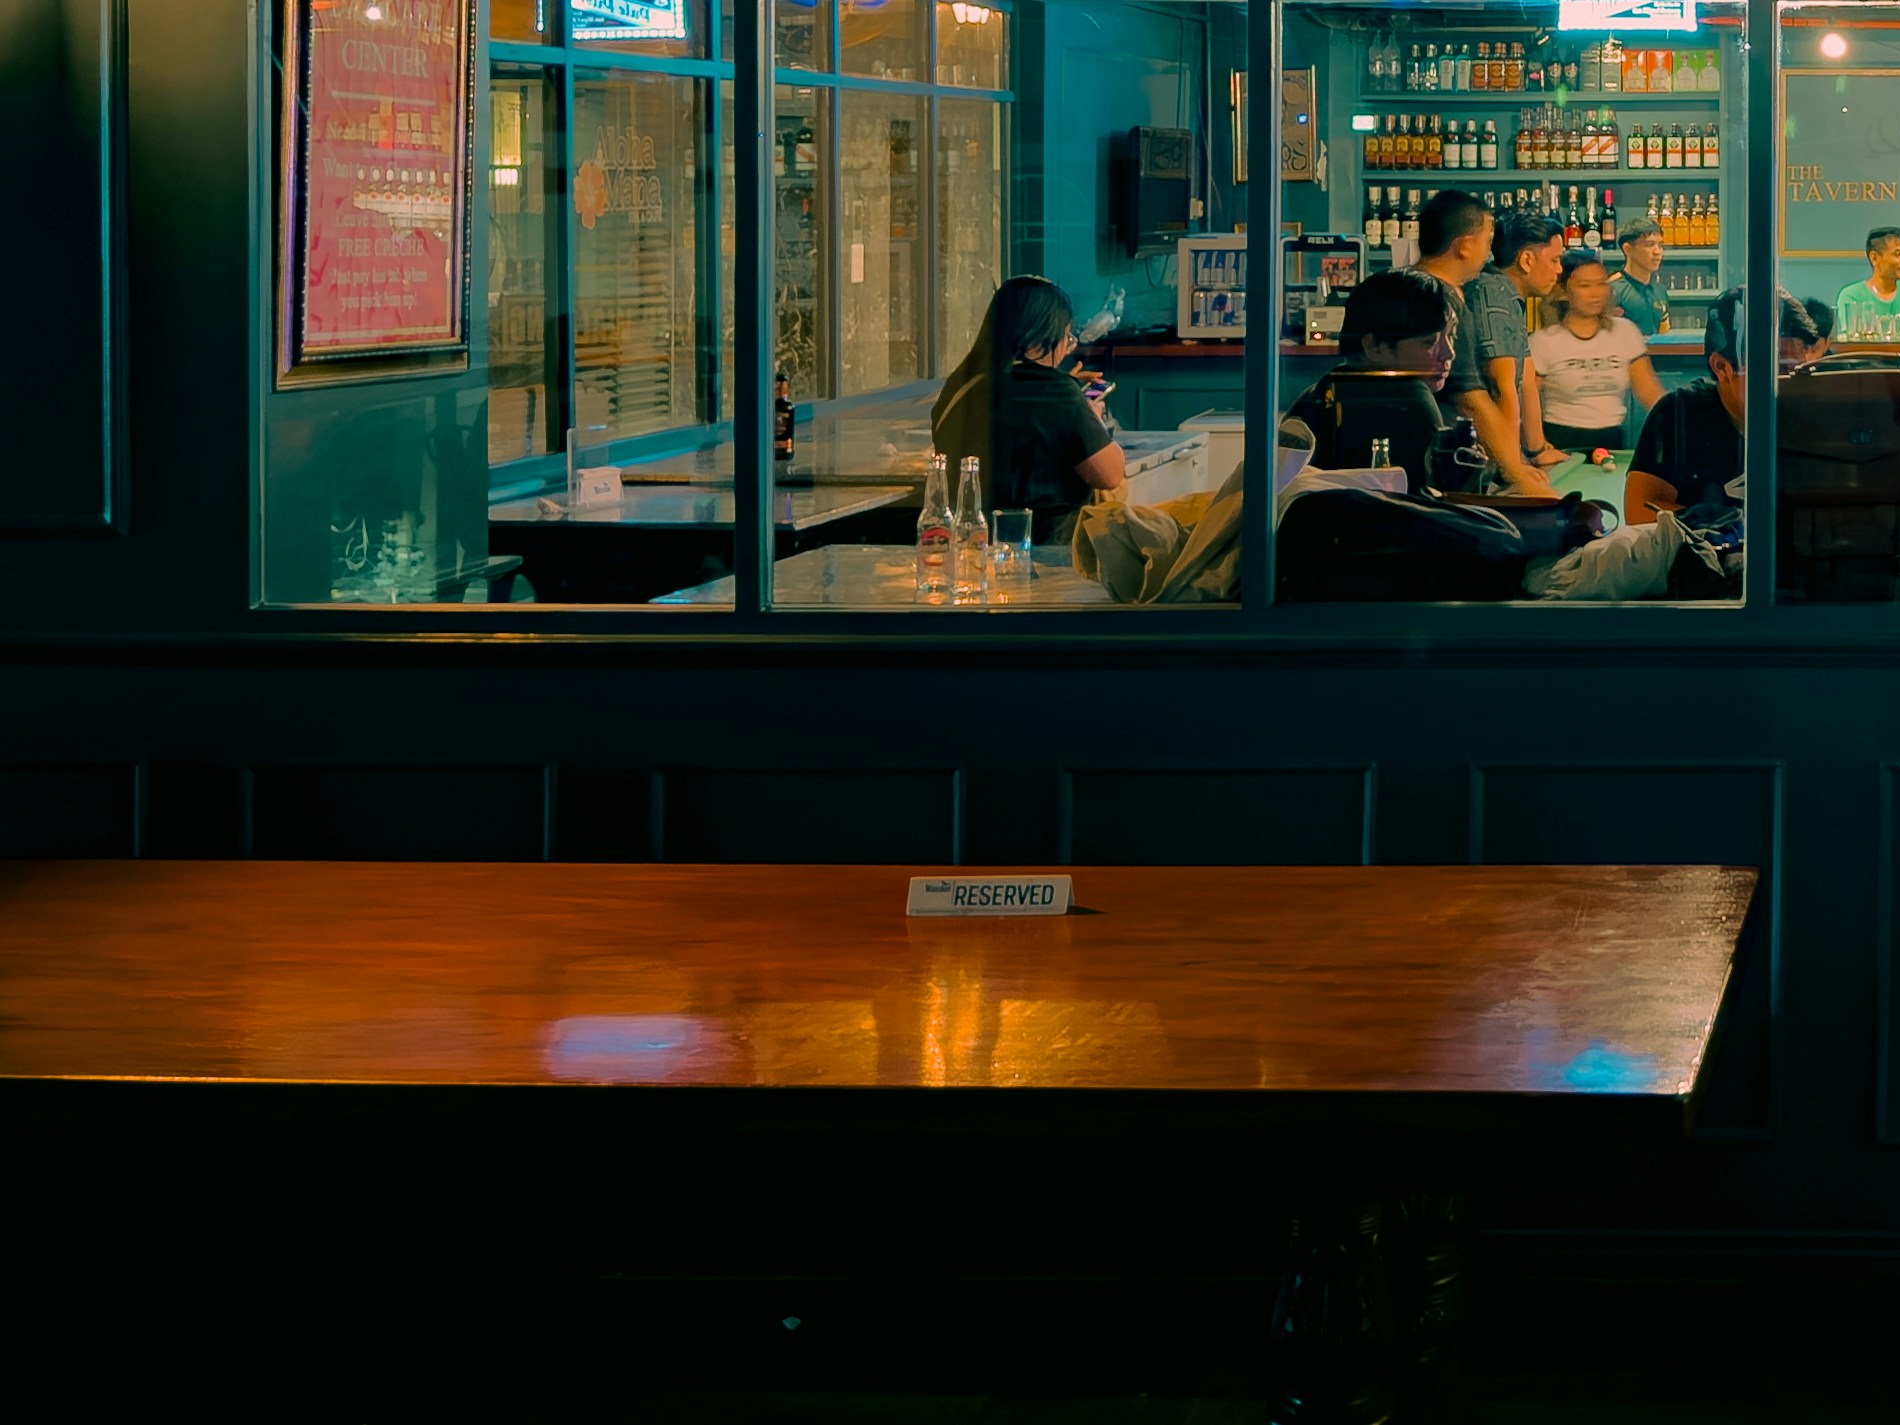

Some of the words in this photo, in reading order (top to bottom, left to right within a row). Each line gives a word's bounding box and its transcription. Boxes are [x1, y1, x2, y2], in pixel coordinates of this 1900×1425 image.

[341, 38, 429, 78] CENTER
[593, 126, 657, 170] Aloha
[1788, 164, 1823, 181] THE
[1788, 180, 1897, 202] TAVERN
[338, 237, 371, 257] FREE
[953, 883, 1055, 906] RESERVED
